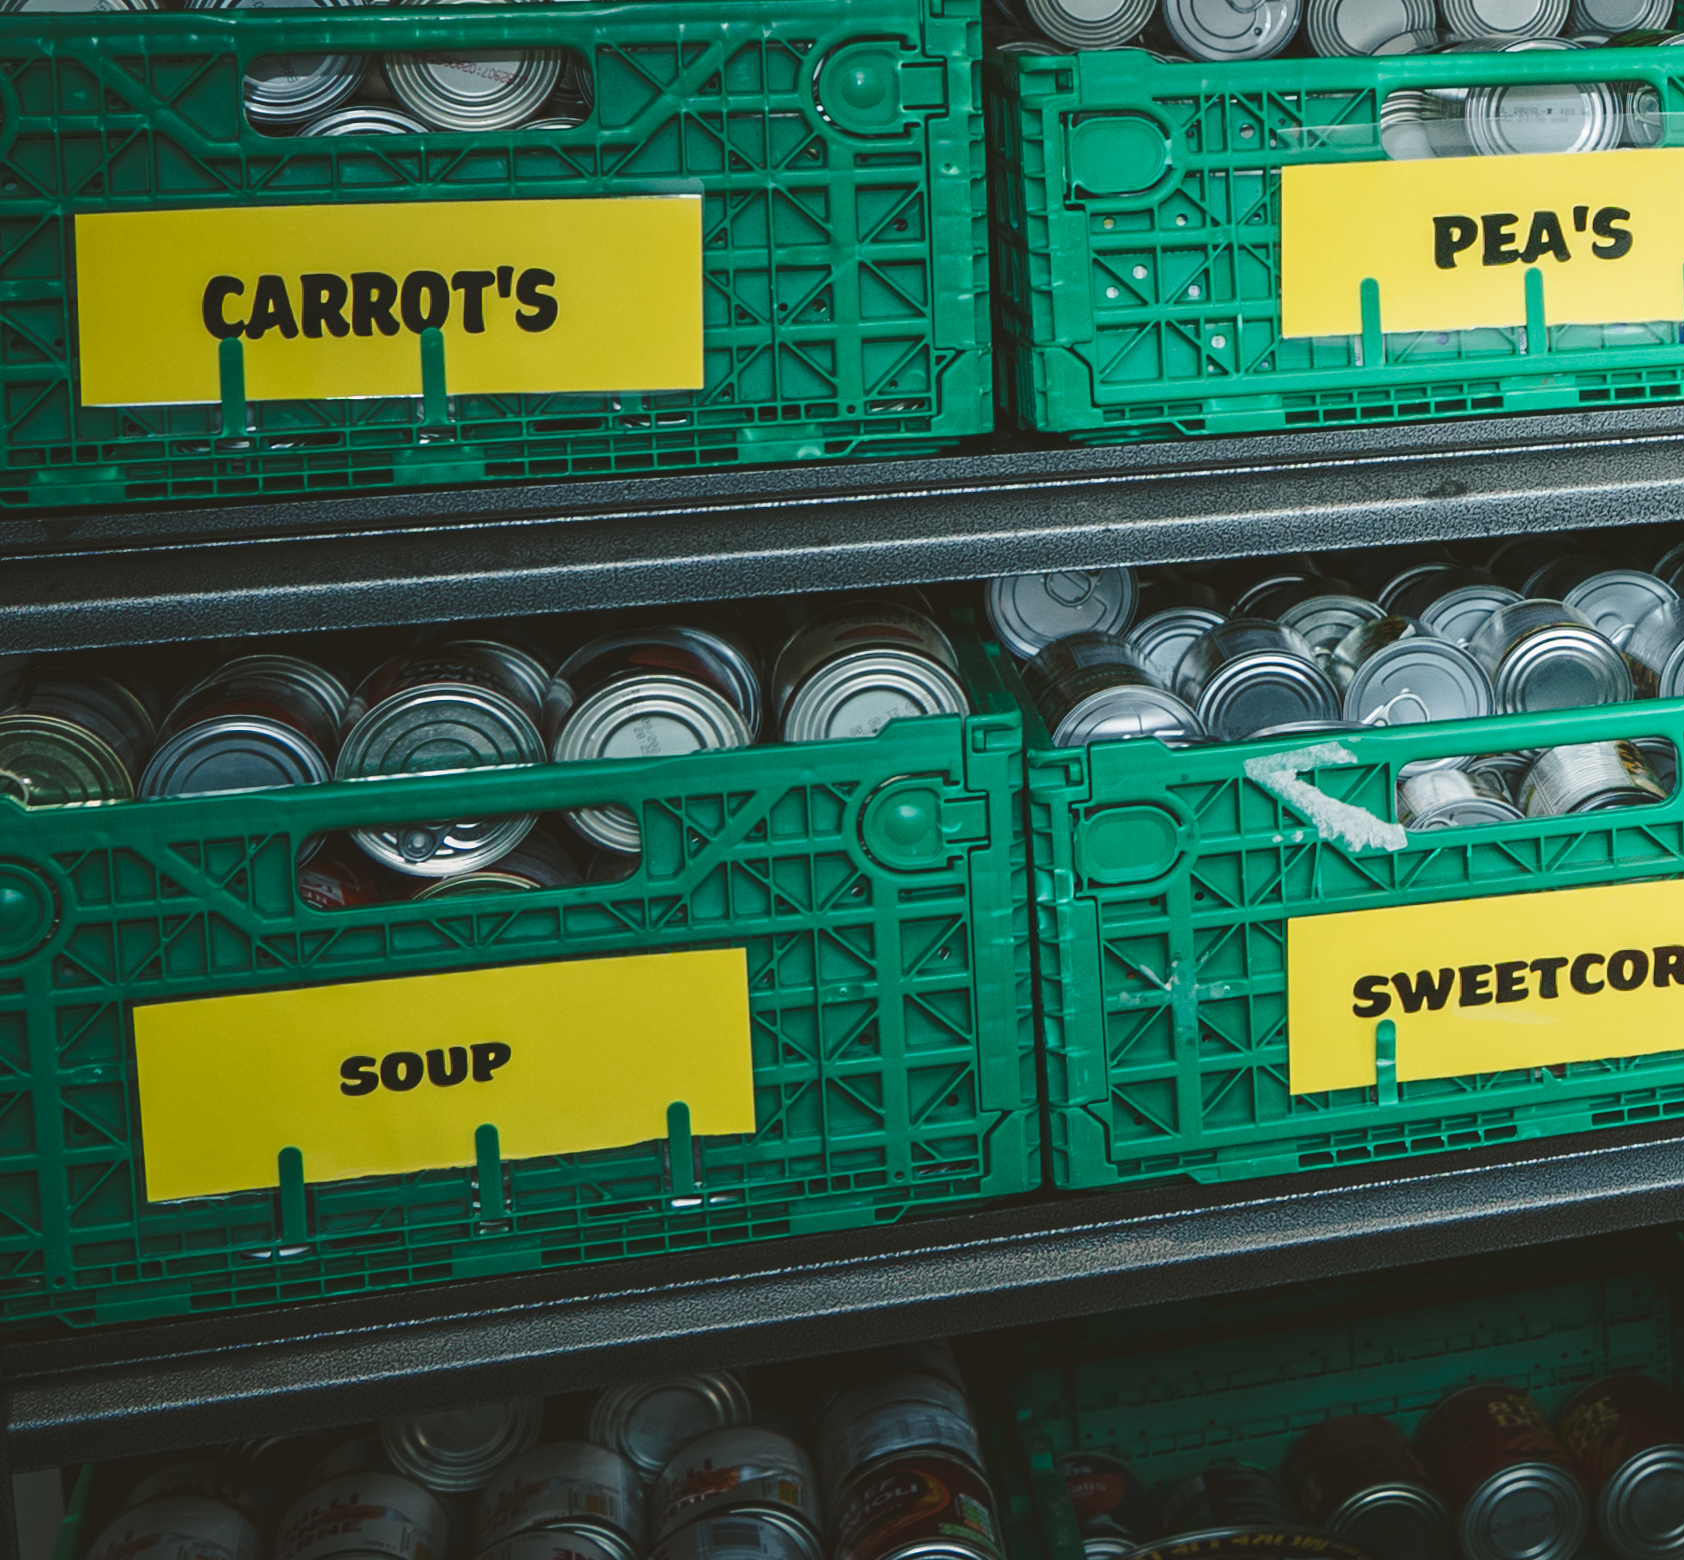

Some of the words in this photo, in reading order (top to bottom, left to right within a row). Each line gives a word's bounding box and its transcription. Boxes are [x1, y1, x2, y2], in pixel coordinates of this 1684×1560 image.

[1431, 205, 1634, 270] PEA'S
[202, 265, 559, 341] CARROT'S
[338, 1041, 512, 1098] SOUP
